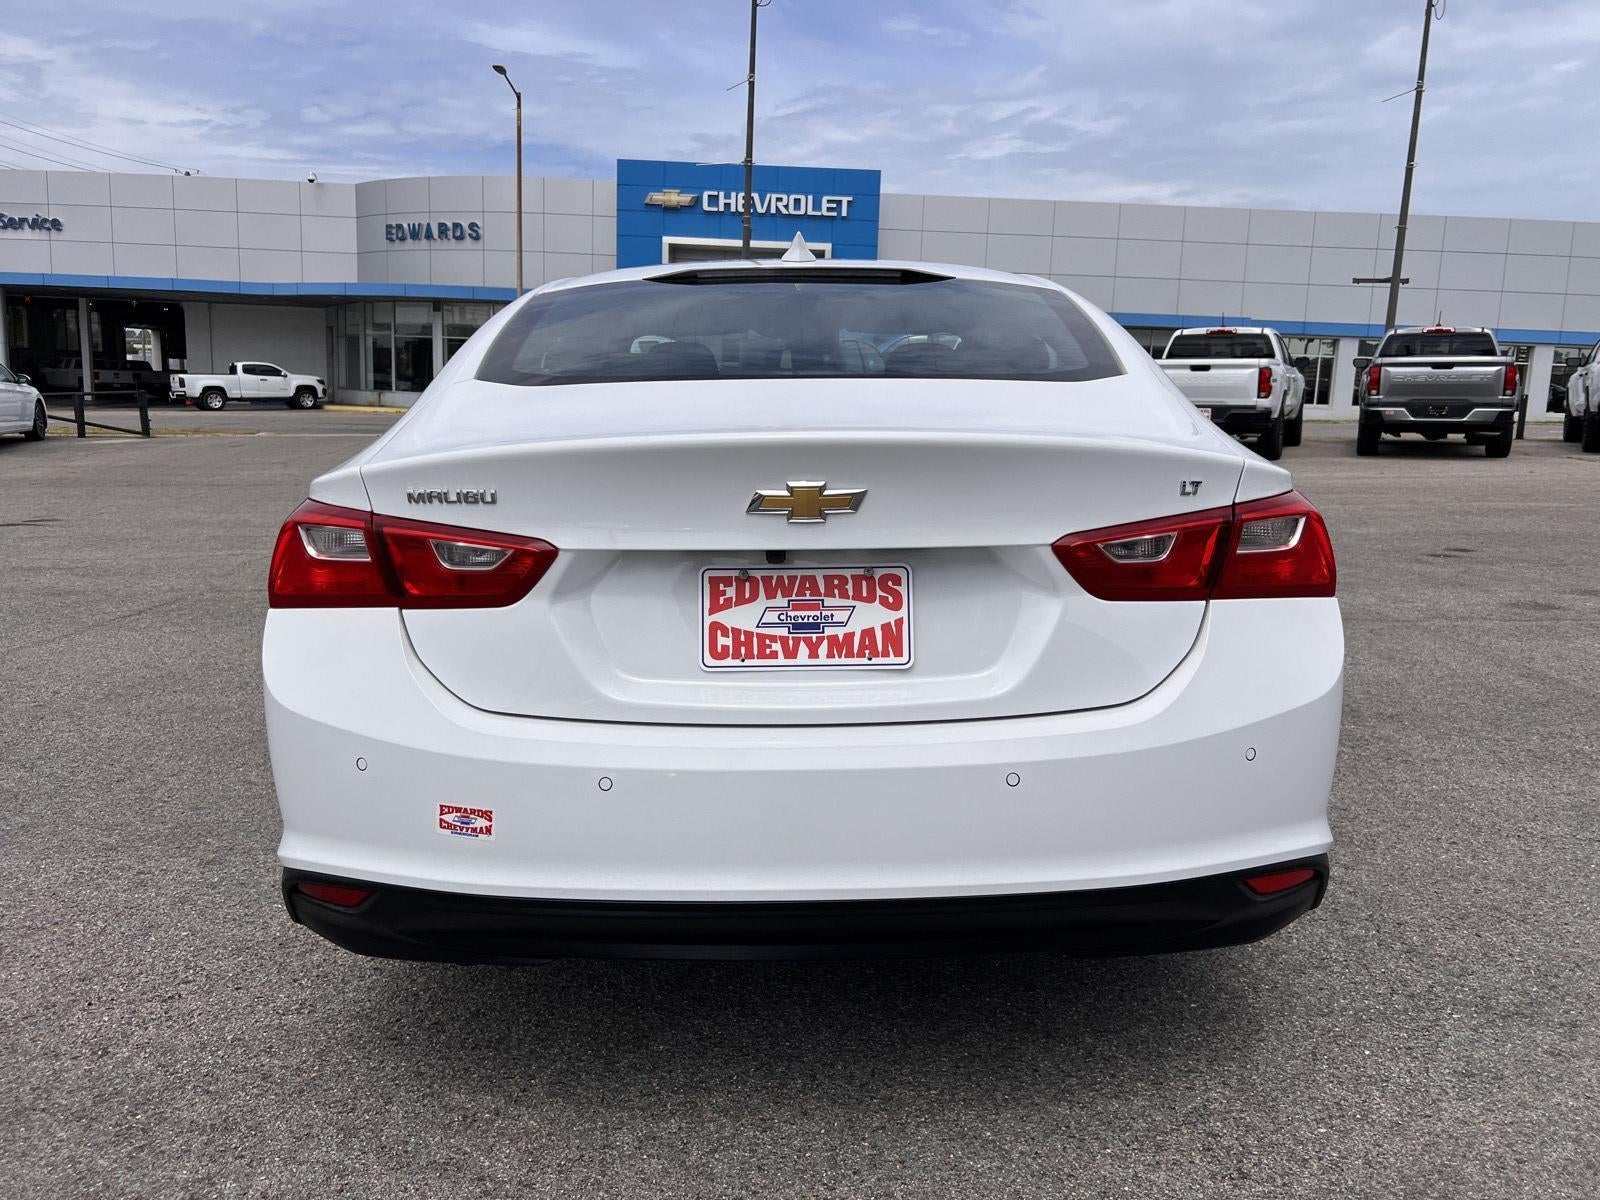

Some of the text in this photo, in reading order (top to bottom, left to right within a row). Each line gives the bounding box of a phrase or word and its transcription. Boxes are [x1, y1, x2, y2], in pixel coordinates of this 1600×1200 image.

[702, 190, 853, 217] CHEVROLET
[0, 212, 63, 232] Service
[385, 222, 481, 242] EDWARDS
[406, 488, 497, 504] MALIBU
[1180, 480, 1202, 496] LT
[708, 573, 904, 617] EDWARDS
[777, 611, 835, 622] Chevrolet
[708, 616, 904, 661] CHEVYMAN
[439, 803, 493, 823] EDWARDS
[439, 817, 493, 836] CHEVYMAN
